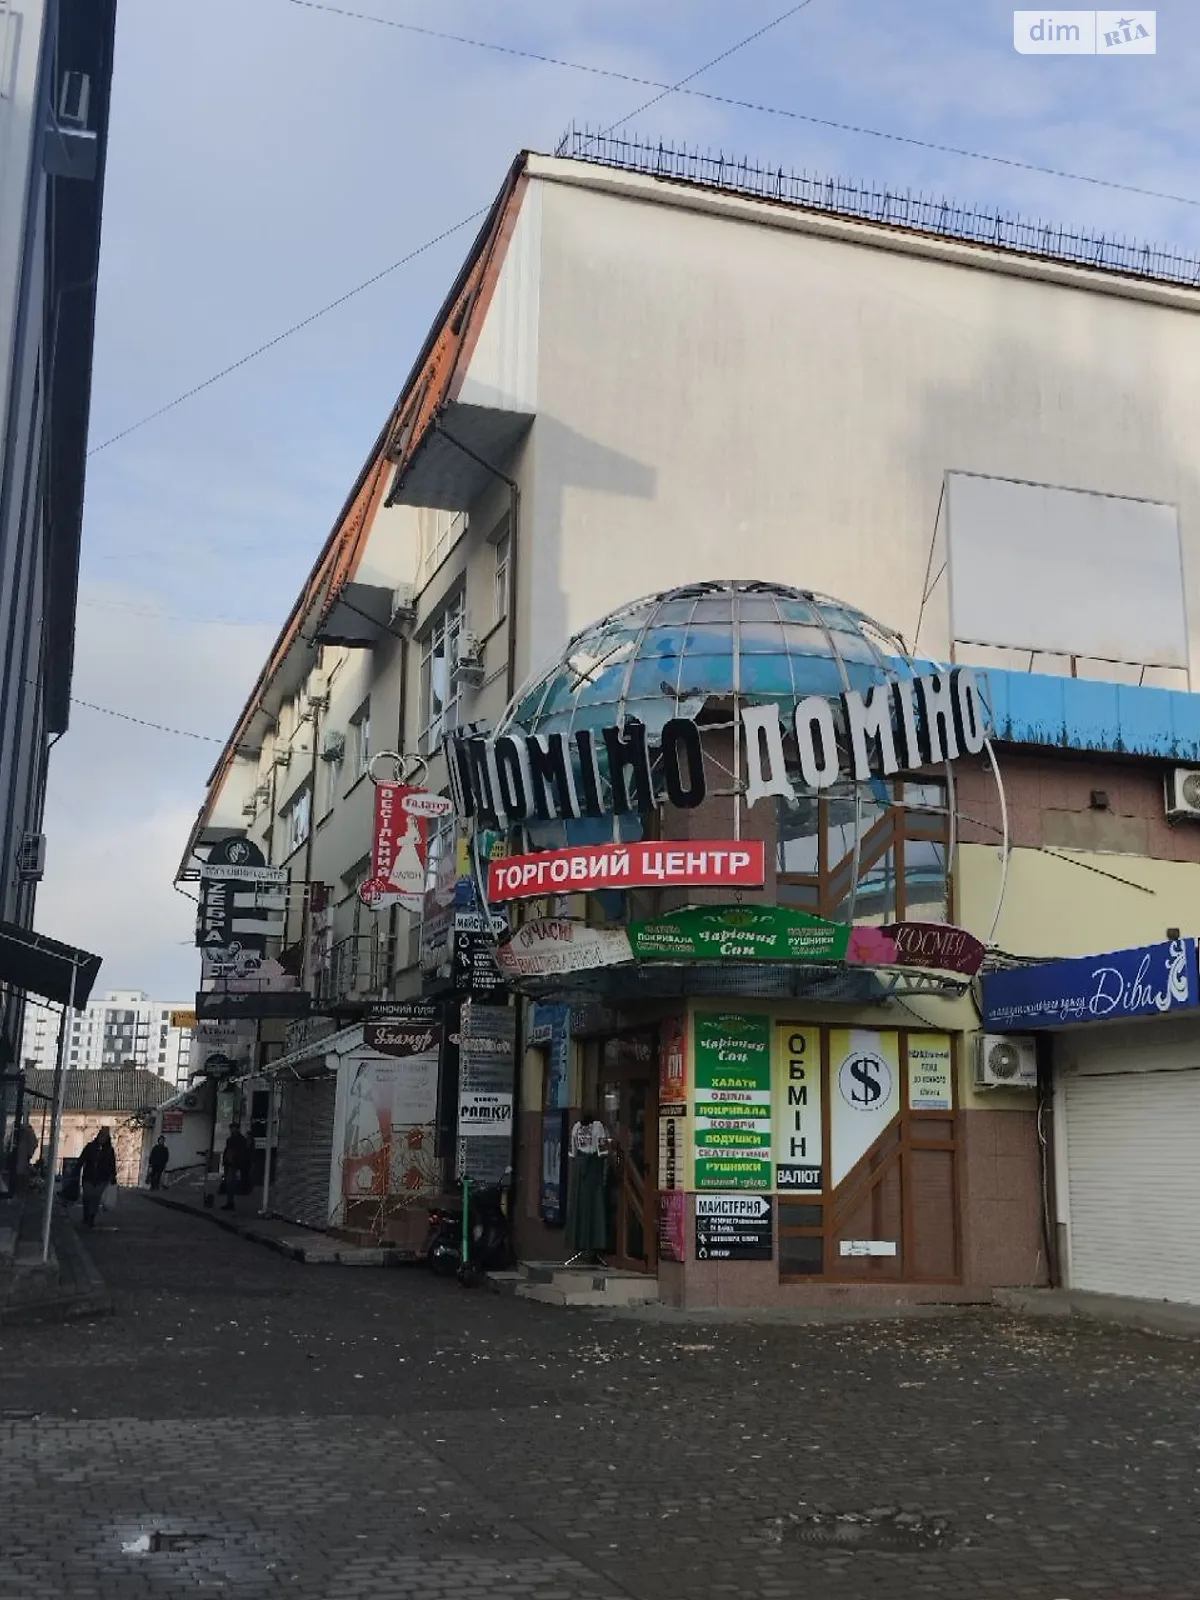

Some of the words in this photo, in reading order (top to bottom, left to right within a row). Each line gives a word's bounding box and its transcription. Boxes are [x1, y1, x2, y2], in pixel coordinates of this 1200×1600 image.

[740, 667, 988, 808] ДОМІНО
[378, 788, 393, 877] ВЕСІЛЬНИЙ
[495, 847, 630, 890] ТОРГОВИЙ
[641, 851, 750, 880] ЦЕНТР
[788, 936, 834, 946] РУШНИКИ
[711, 1078, 757, 1088] ХАЛАТИ
[787, 1033, 807, 1157] ОБМІН
[700, 1106, 767, 1116] ПОКРИВАЛА
[710, 1120, 755, 1129] КОВДРИ
[705, 1134, 761, 1145] ПОДУШКИ
[706, 1162, 761, 1172] РУШНИКИ
[777, 1169, 821, 1184] ВАЛЮТ
[698, 1199, 761, 1213] МАЙСТЕРНЯ
